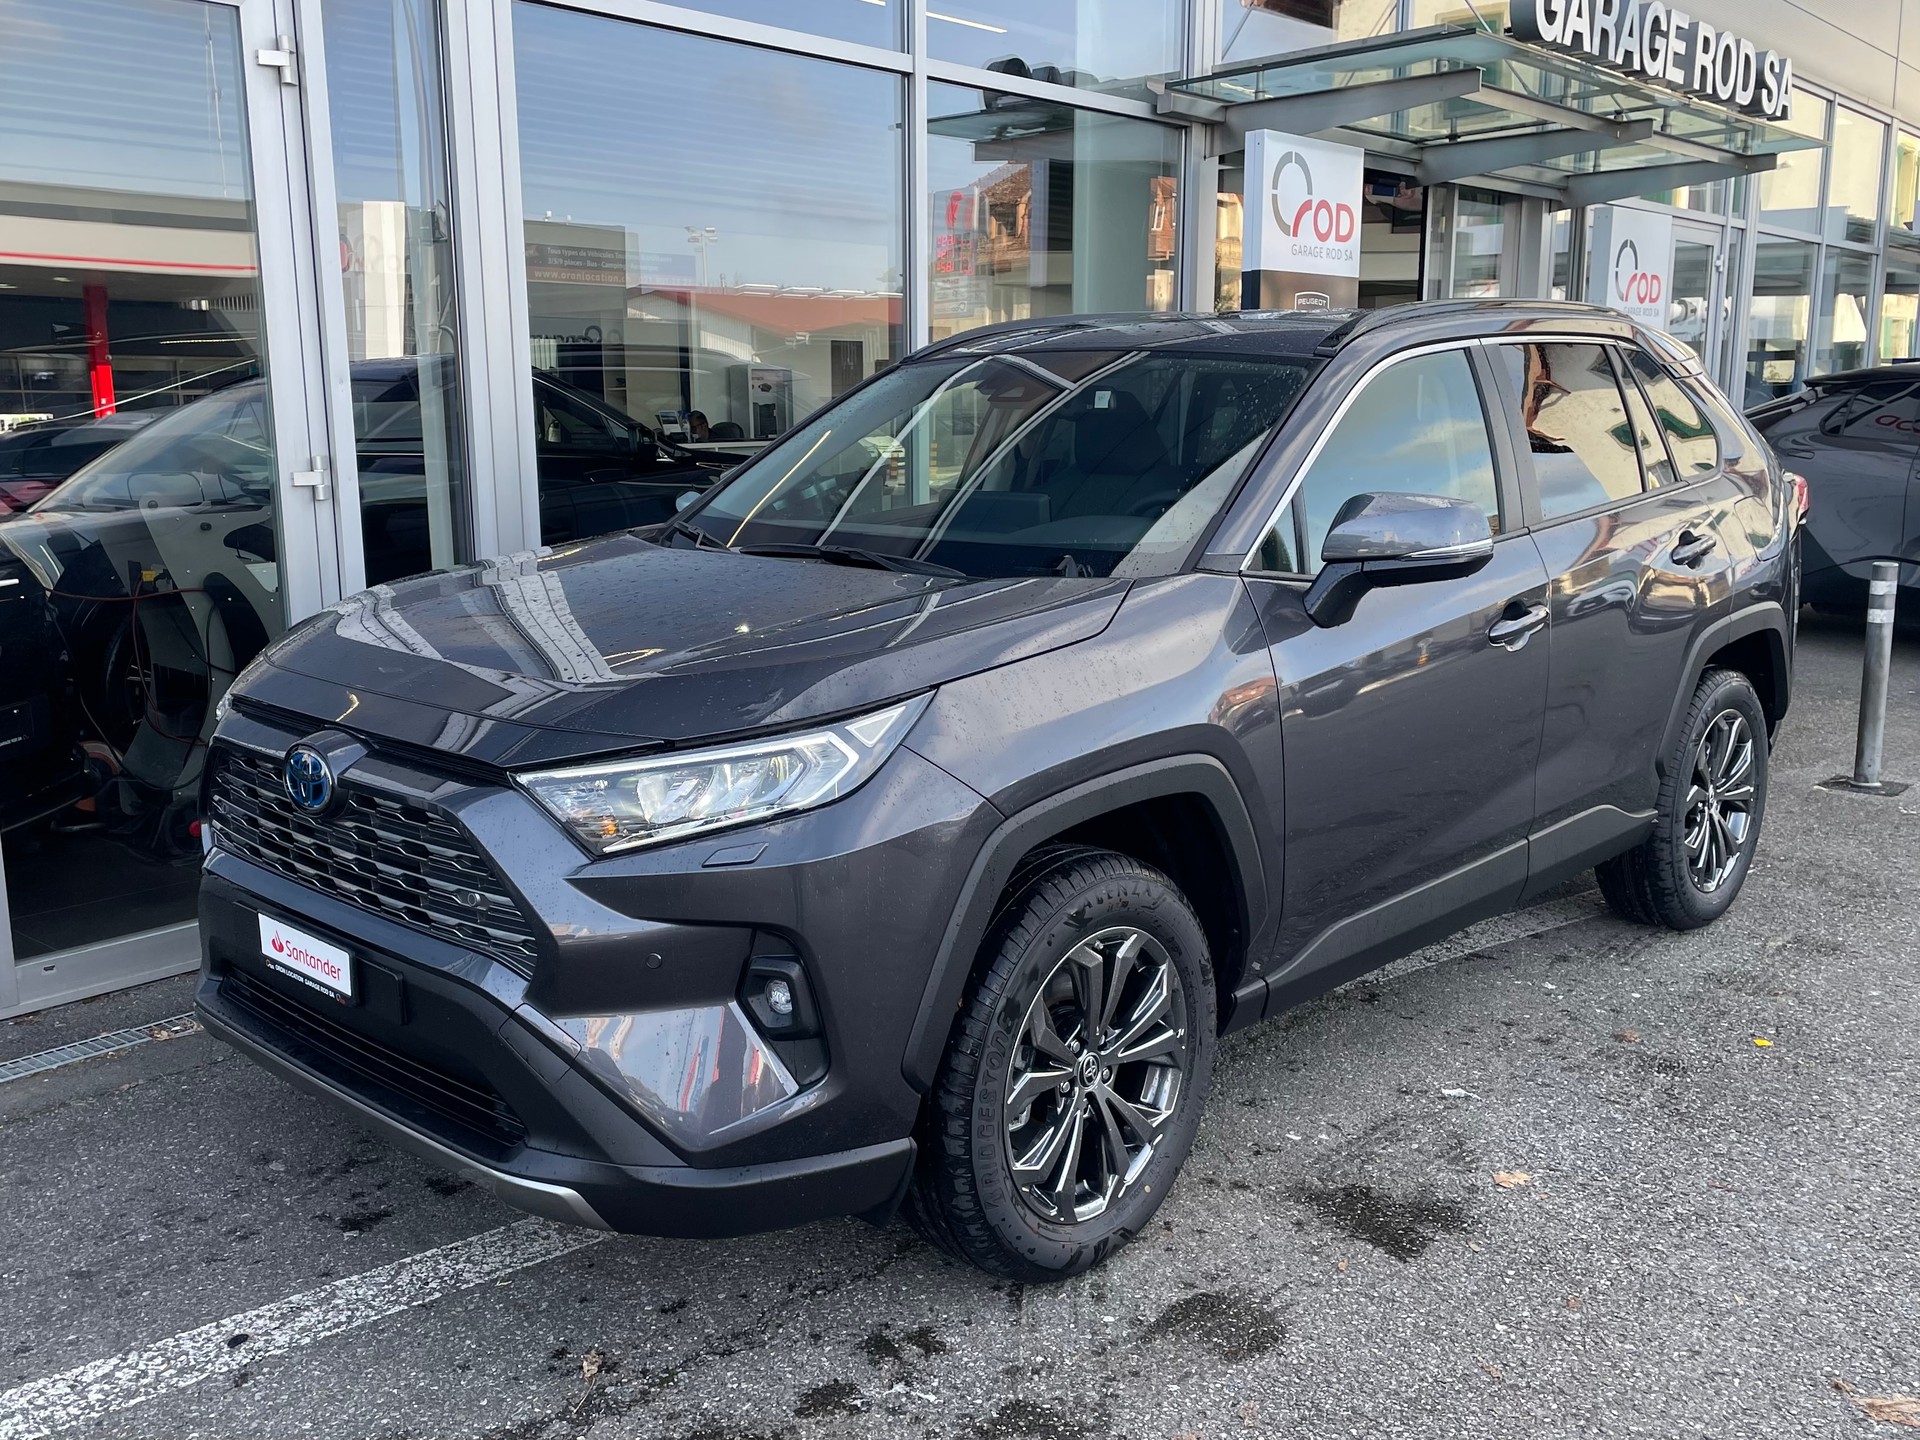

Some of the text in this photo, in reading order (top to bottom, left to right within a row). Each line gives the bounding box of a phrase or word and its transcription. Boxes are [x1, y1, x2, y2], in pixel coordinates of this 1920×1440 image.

[1535, 0, 1792, 120] GARAGE ROD SA
[547, 247, 560, 255] Tous
[562, 248, 577, 256] types
[1291, 243, 1353, 261] GARAGE ROD SA
[1297, 297, 1327, 306] PEUGEOT
[1642, 307, 1652, 316] ROD
[285, 940, 342, 980] Santander
[304, 978, 320, 991] GARAGE
